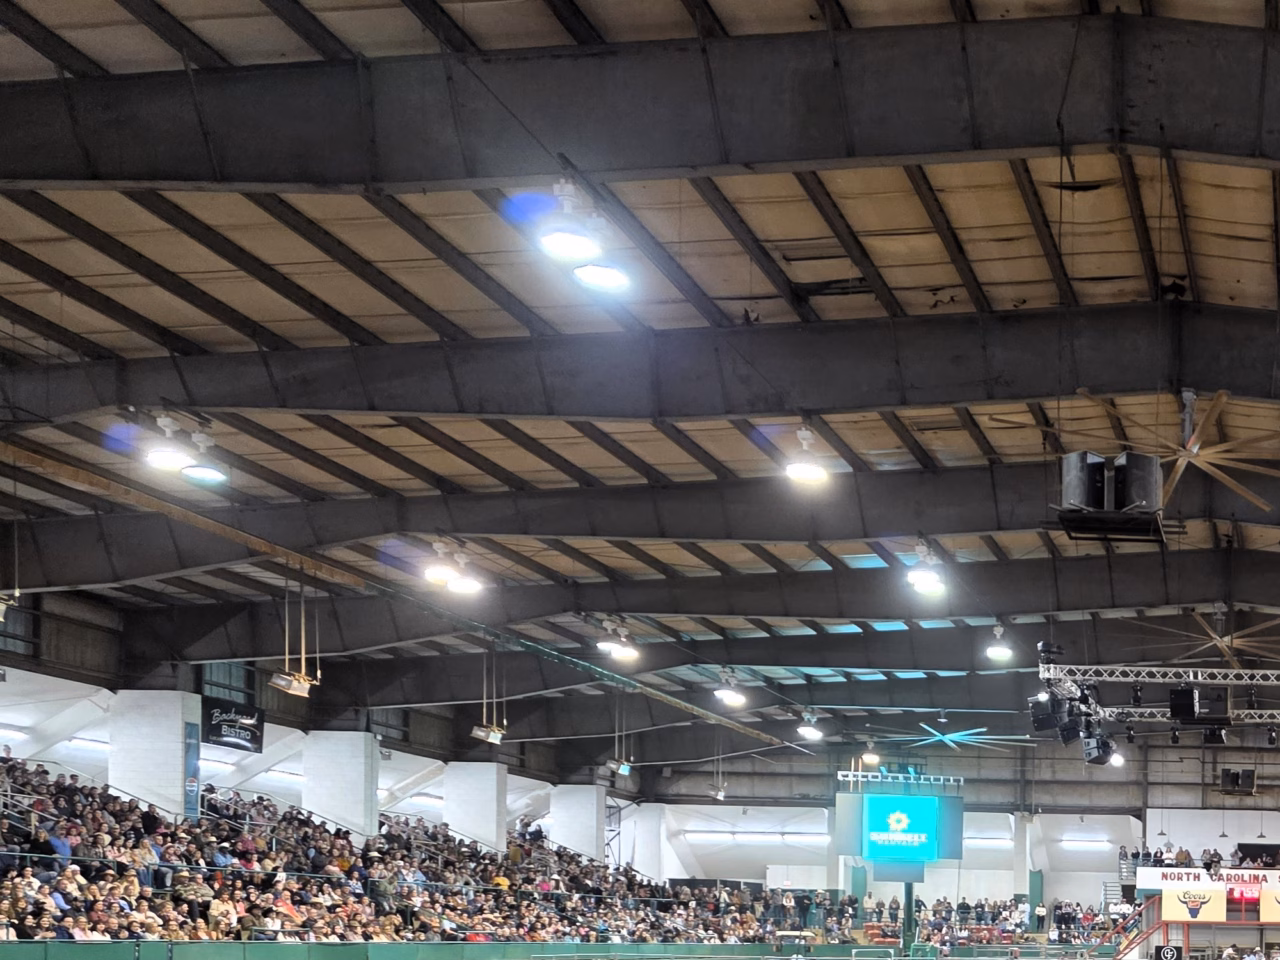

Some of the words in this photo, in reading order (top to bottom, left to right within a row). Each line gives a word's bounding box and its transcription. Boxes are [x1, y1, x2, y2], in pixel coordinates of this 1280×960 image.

[221, 725, 251, 739] BISTRO
[1161, 871, 1201, 882] NORTH
[1209, 872, 1268, 884] CAROLINA
